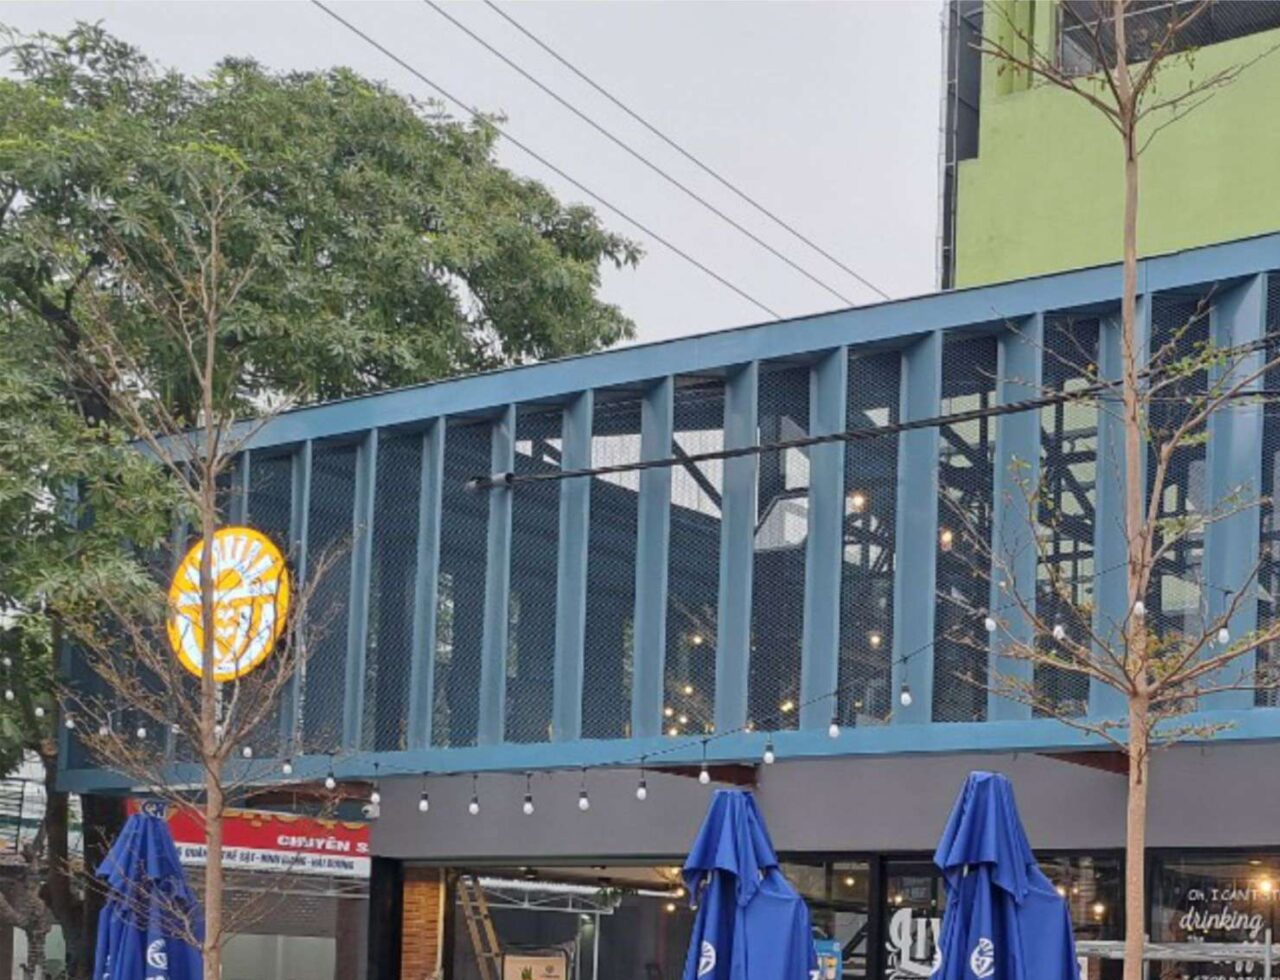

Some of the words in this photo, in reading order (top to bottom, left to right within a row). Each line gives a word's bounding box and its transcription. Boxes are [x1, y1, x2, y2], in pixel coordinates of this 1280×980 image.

[277, 833, 350, 853] CHUYÊN
[356, 841, 370, 854] S
[1179, 905, 1264, 938] drinking
